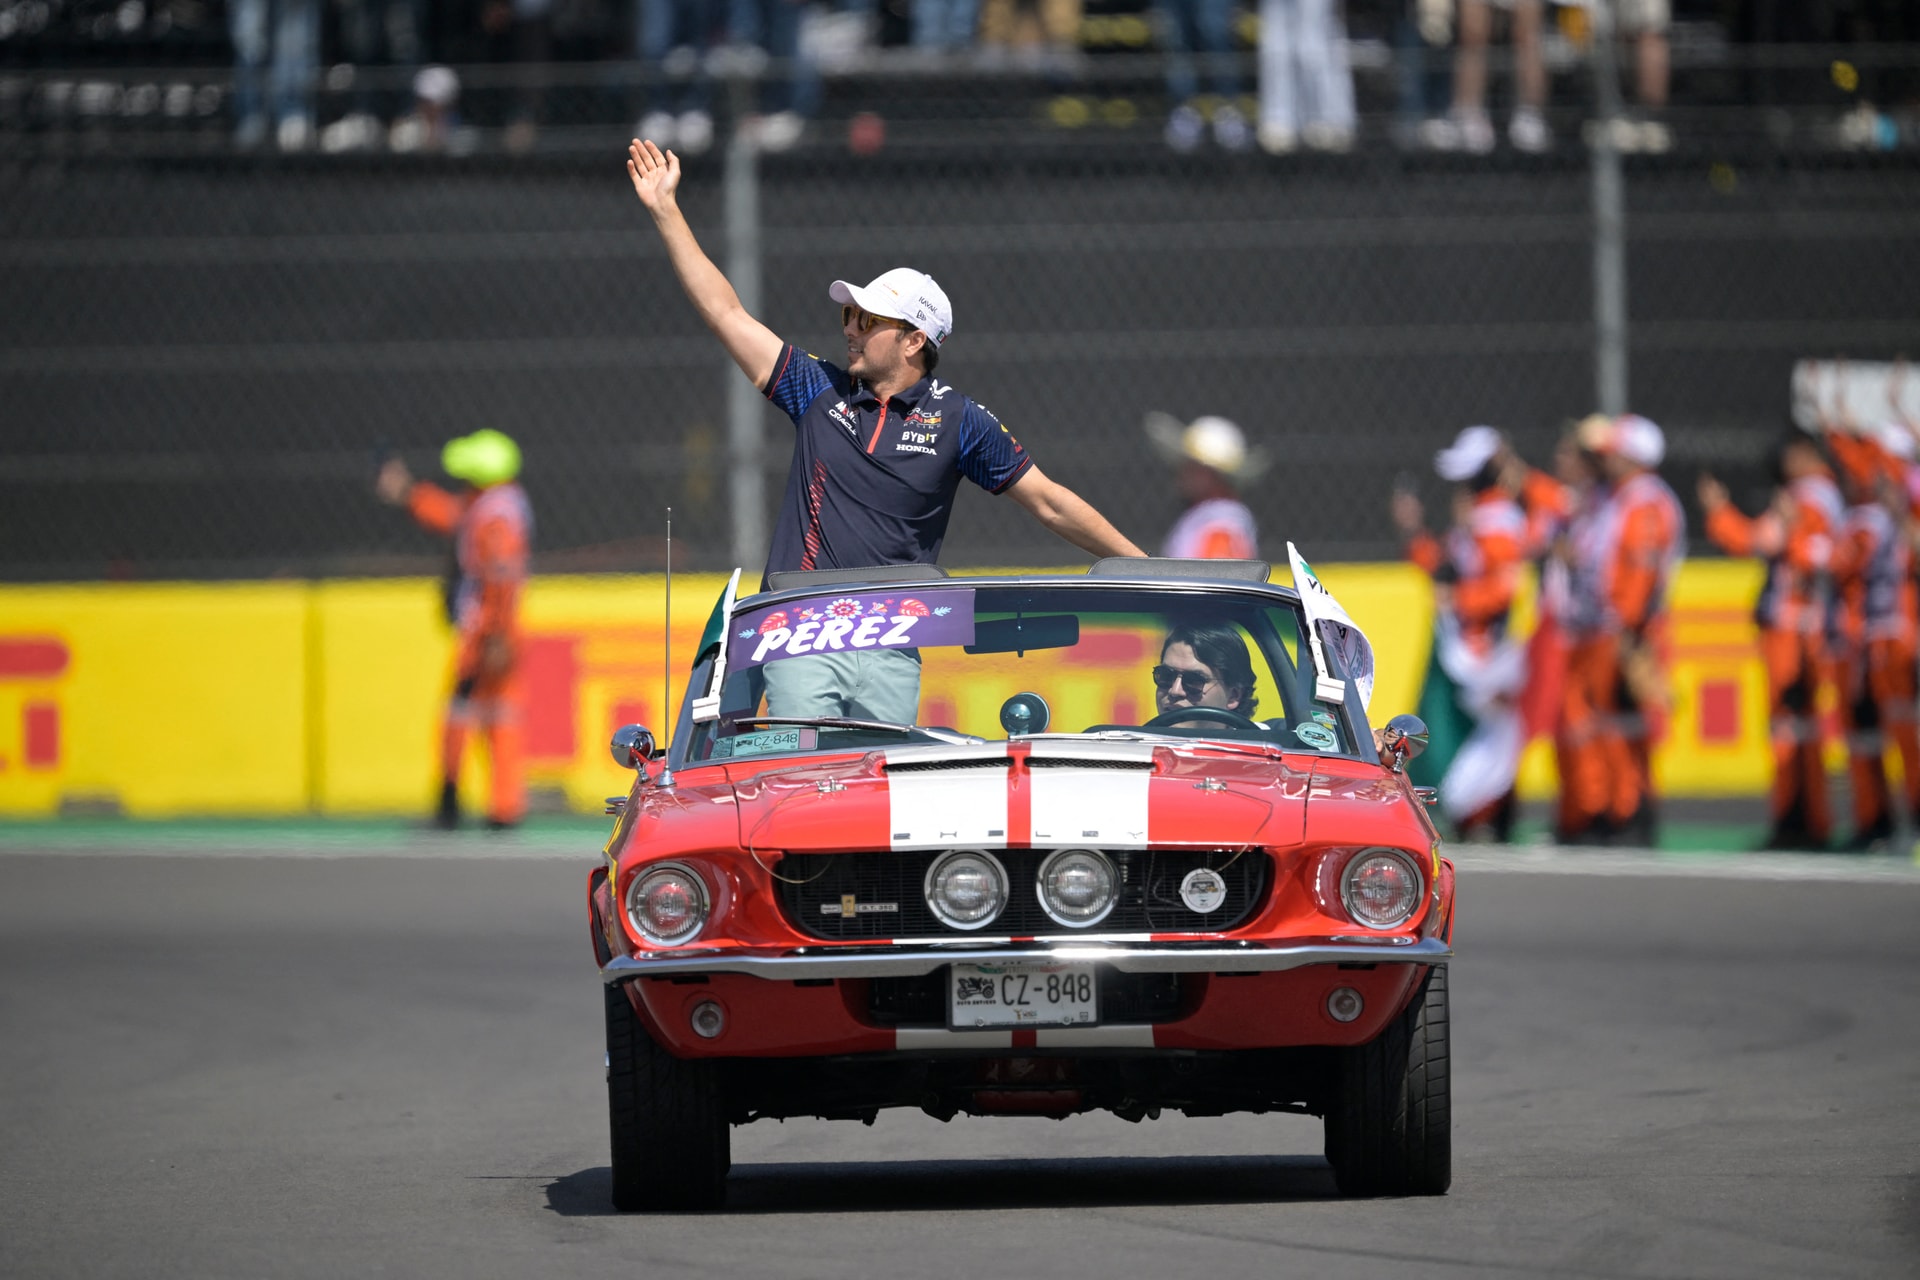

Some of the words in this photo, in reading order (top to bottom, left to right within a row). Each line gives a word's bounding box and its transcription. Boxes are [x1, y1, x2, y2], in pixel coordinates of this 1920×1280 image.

[919, 296, 938, 314] KAVAK
[902, 431, 938, 444] BYBIT
[896, 444, 937, 455] HONDA
[751, 613, 919, 662] PÉREZ
[754, 733, 798, 747] CZ-848
[1001, 973, 1092, 1006] CZ-848
